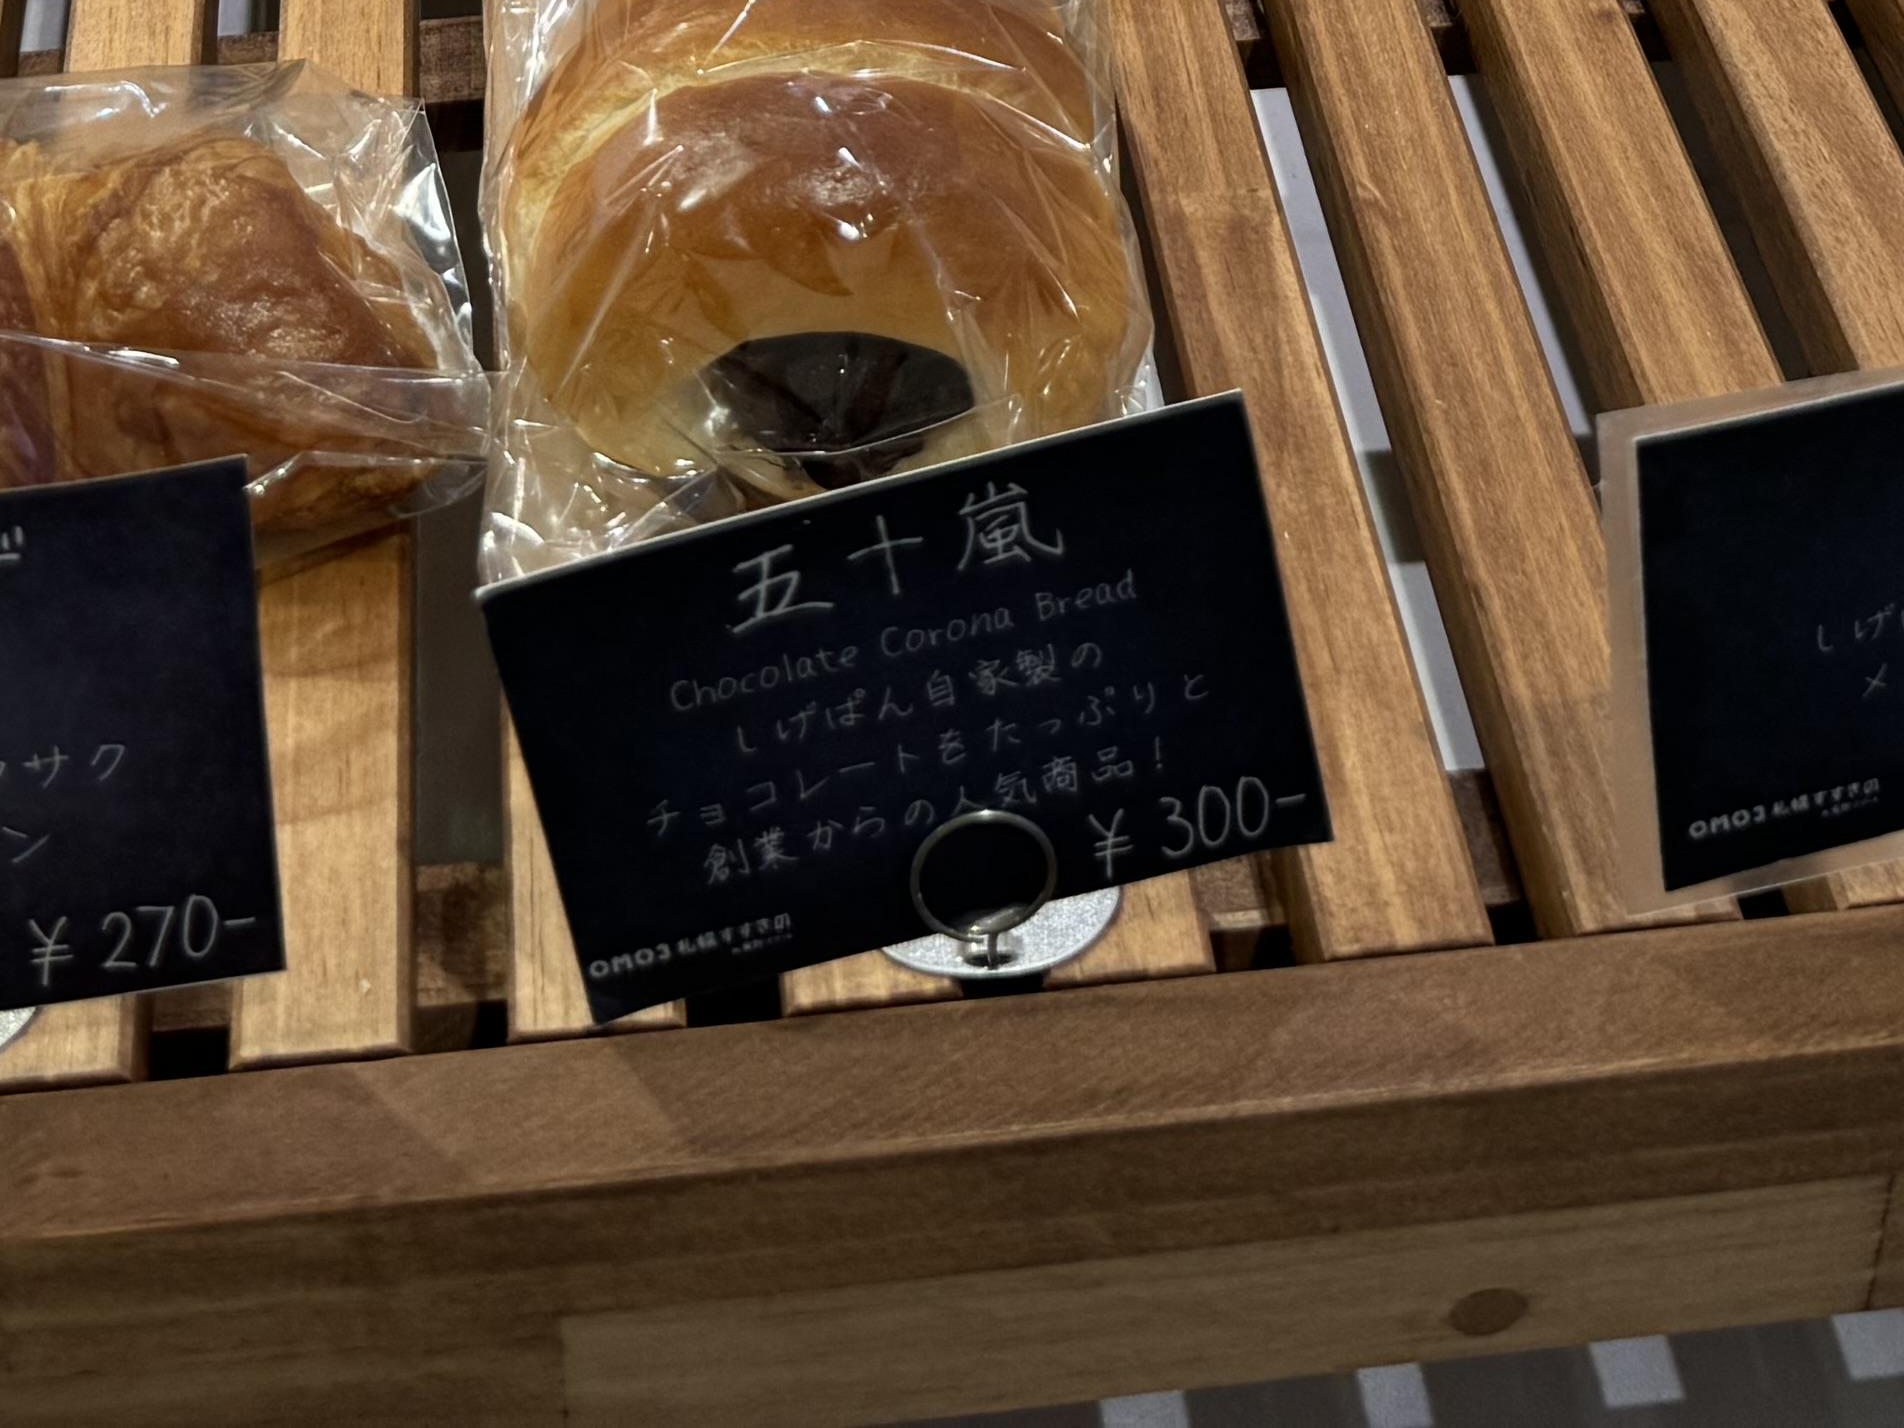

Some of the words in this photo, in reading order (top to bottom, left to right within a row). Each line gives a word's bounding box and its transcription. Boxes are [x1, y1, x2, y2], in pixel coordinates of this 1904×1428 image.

[727, 478, 1064, 635] 五十嵐
[669, 639, 859, 712] Chocolate
[880, 603, 1016, 659] Corona
[1035, 569, 1137, 621] Bread
[589, 943, 671, 978] OMO3
